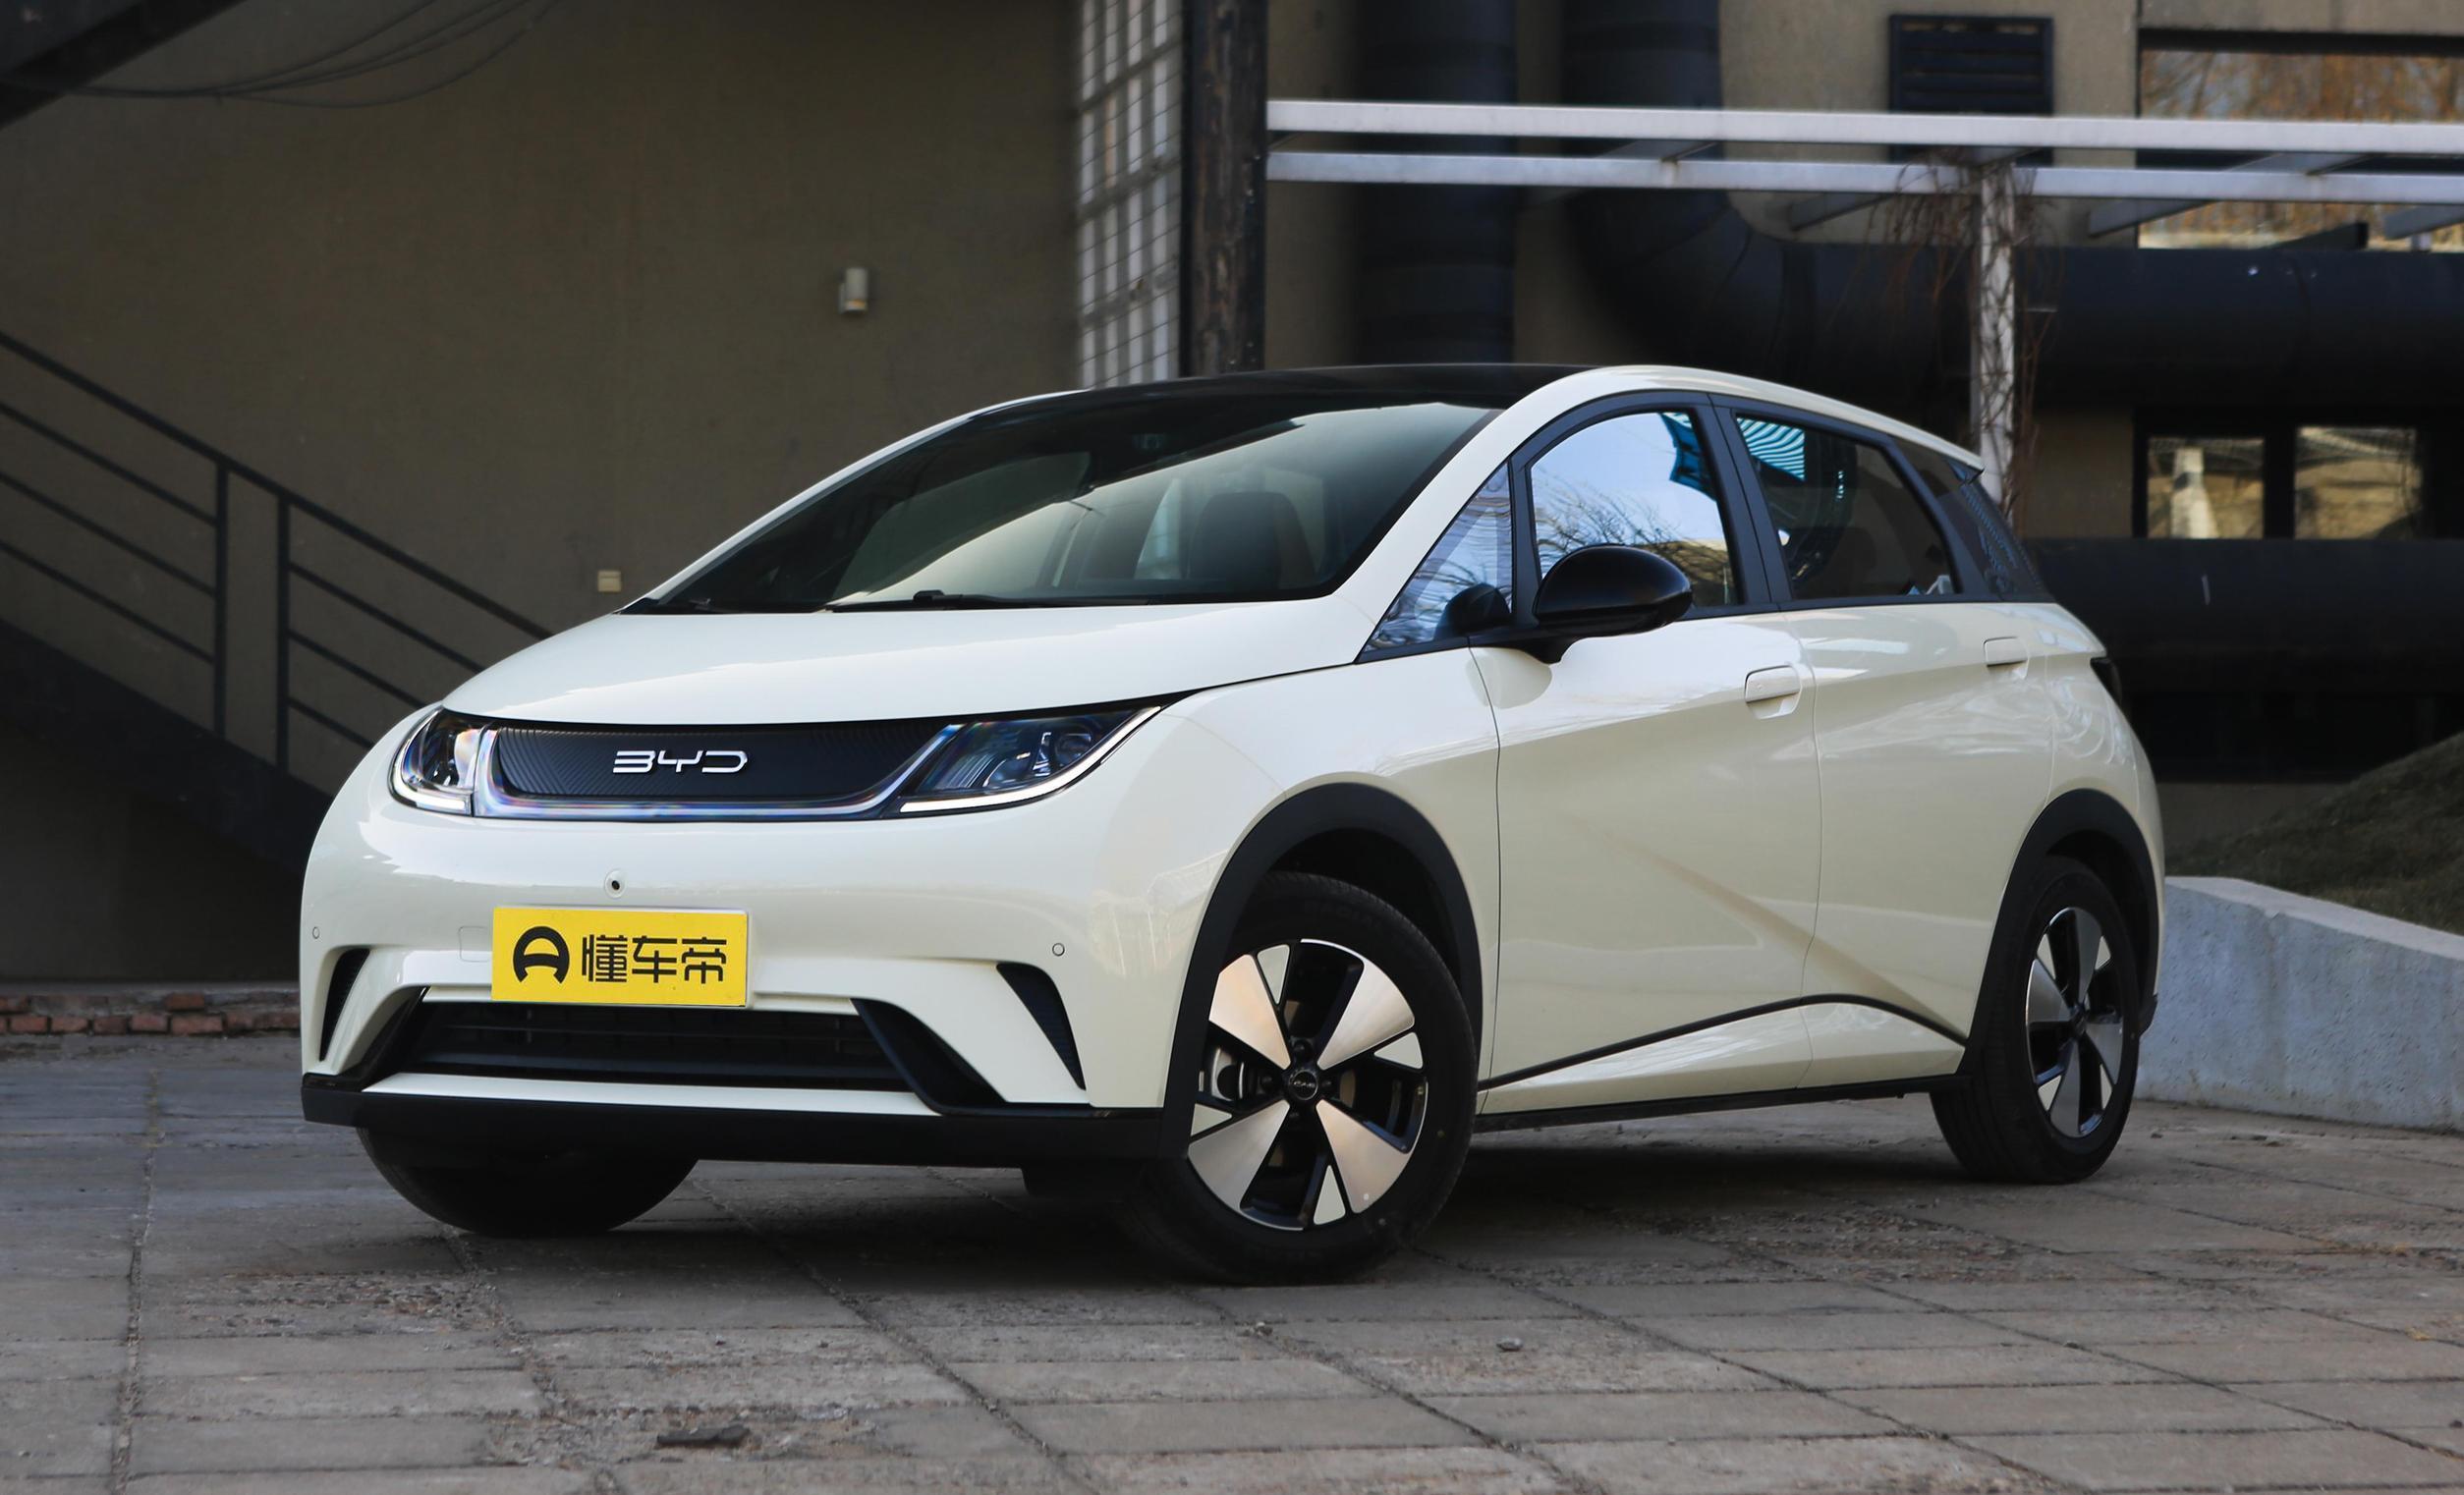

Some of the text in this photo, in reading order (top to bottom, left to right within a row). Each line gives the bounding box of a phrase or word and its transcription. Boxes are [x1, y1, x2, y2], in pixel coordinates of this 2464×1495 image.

[612, 749, 748, 774] BYD
[582, 934, 727, 984] 懂车帝
